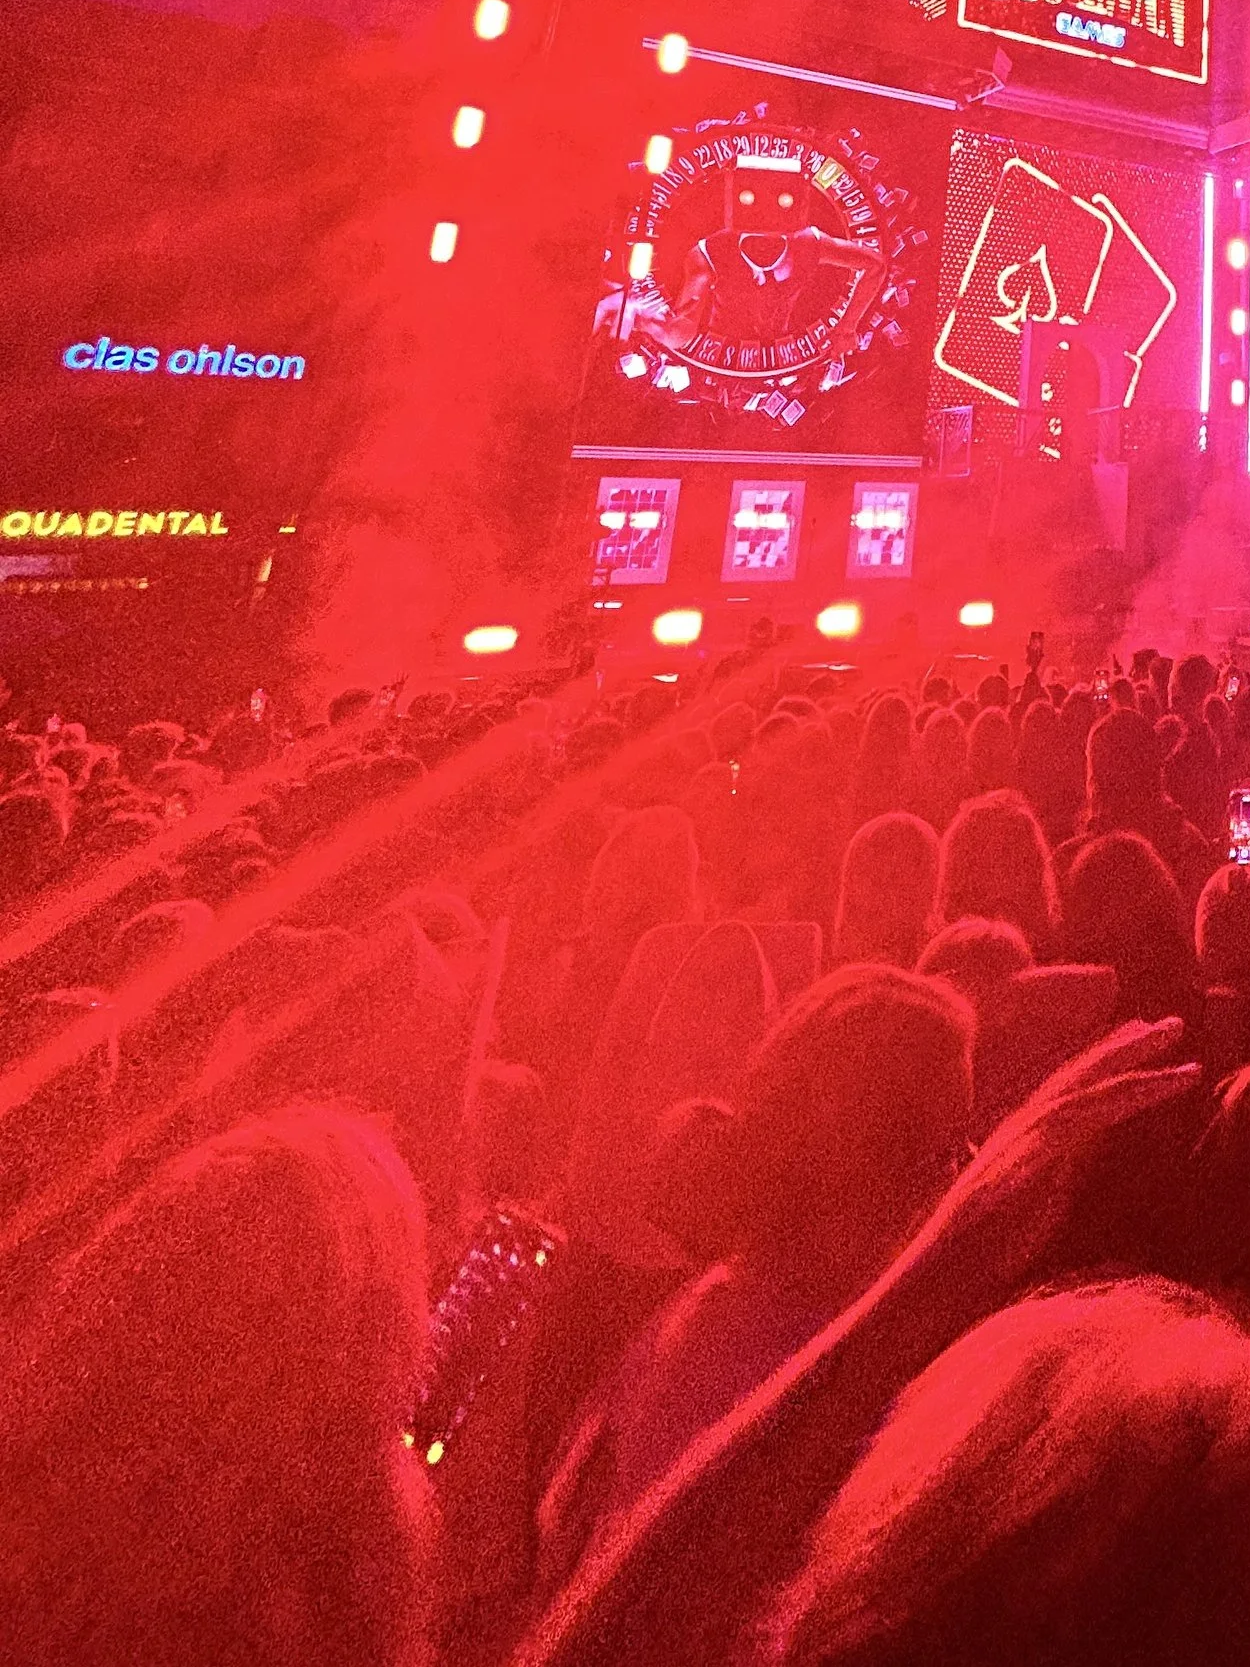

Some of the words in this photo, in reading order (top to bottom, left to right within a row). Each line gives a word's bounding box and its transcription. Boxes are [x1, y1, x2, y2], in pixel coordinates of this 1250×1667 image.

[693, 144, 716, 169] 22
[713, 138, 733, 162] 18
[732, 135, 751, 156] 29
[754, 135, 769, 157] 12
[771, 137, 789, 159] 35
[63, 336, 160, 373] clas
[166, 343, 306, 380] ohlson
